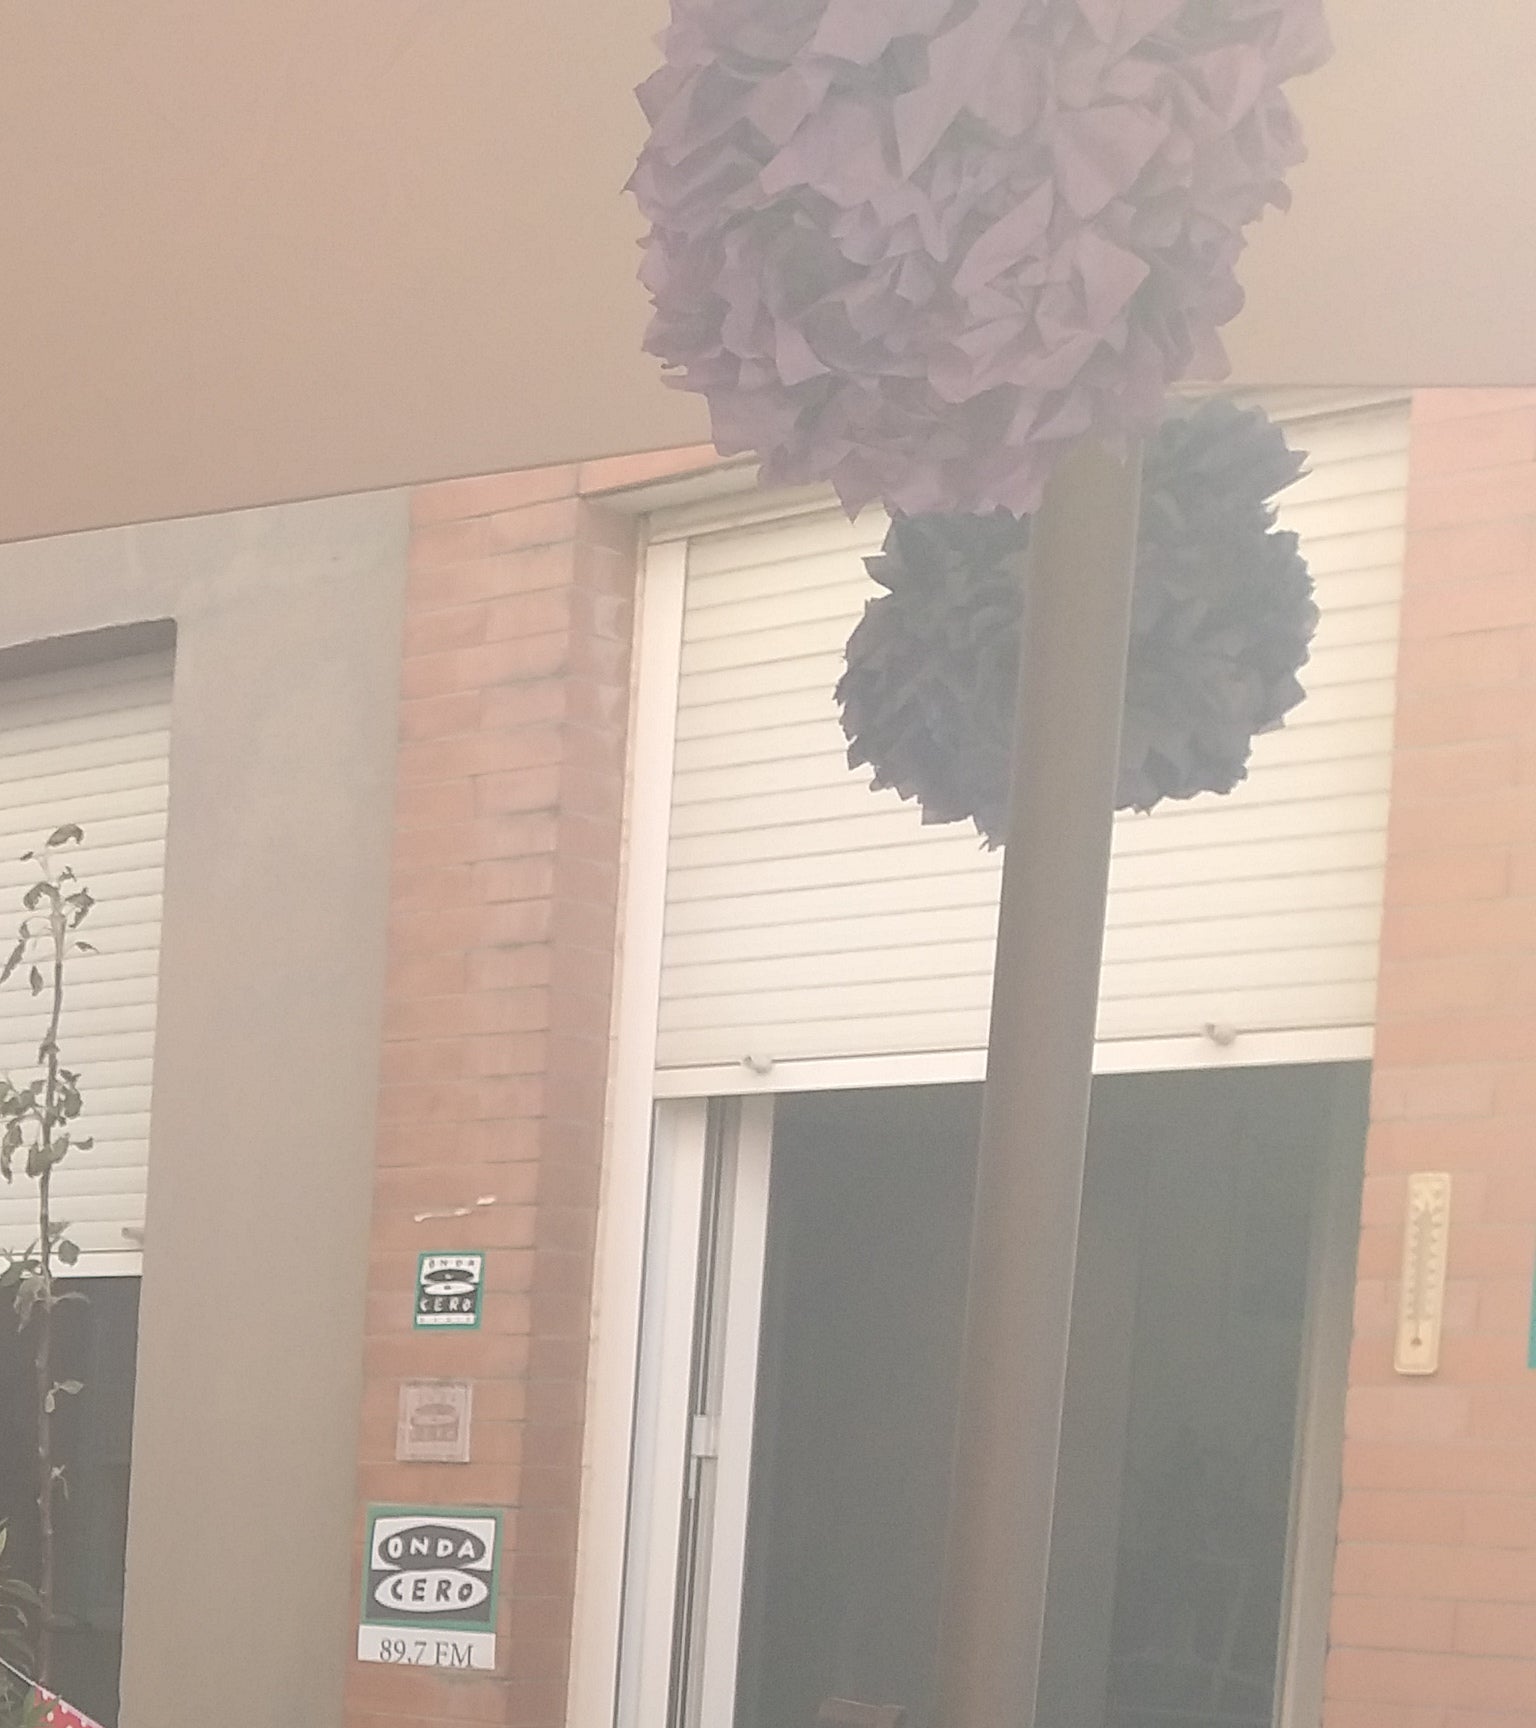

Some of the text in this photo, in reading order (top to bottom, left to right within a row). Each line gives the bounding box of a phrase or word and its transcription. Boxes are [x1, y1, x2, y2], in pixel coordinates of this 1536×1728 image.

[420, 1297, 471, 1311] CERO
[387, 1539, 476, 1560] ONDA
[392, 1580, 472, 1602] CERO
[434, 1642, 474, 1667] FM
